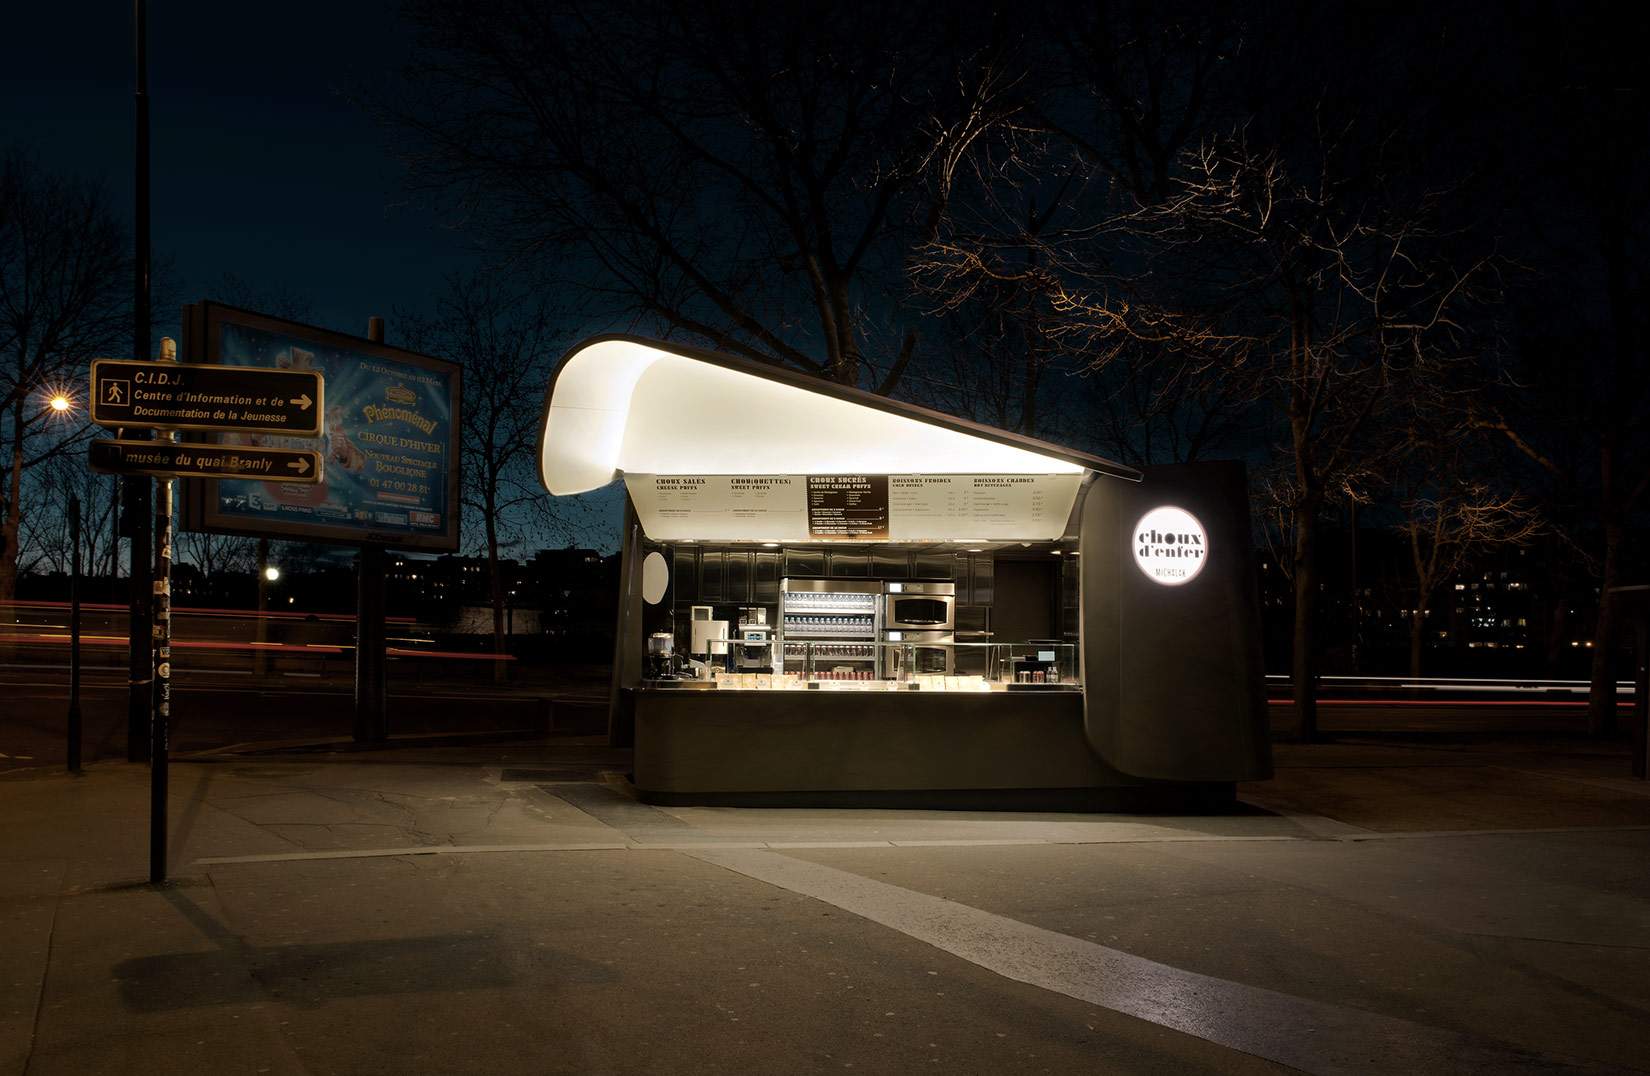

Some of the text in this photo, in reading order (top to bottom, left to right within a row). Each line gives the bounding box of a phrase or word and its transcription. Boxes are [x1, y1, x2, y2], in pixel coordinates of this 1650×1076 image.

[134, 371, 184, 386] C.I.D.J.
[134, 389, 284, 407] Centre d'Information et de
[133, 405, 287, 423] Documentation de la Jeunesse
[358, 431, 441, 453] CIRQUE D'HIVER
[125, 452, 273, 472] musée du quai Branly
[1138, 529, 1202, 545] choux
[1138, 545, 1204, 558] d'enfer
